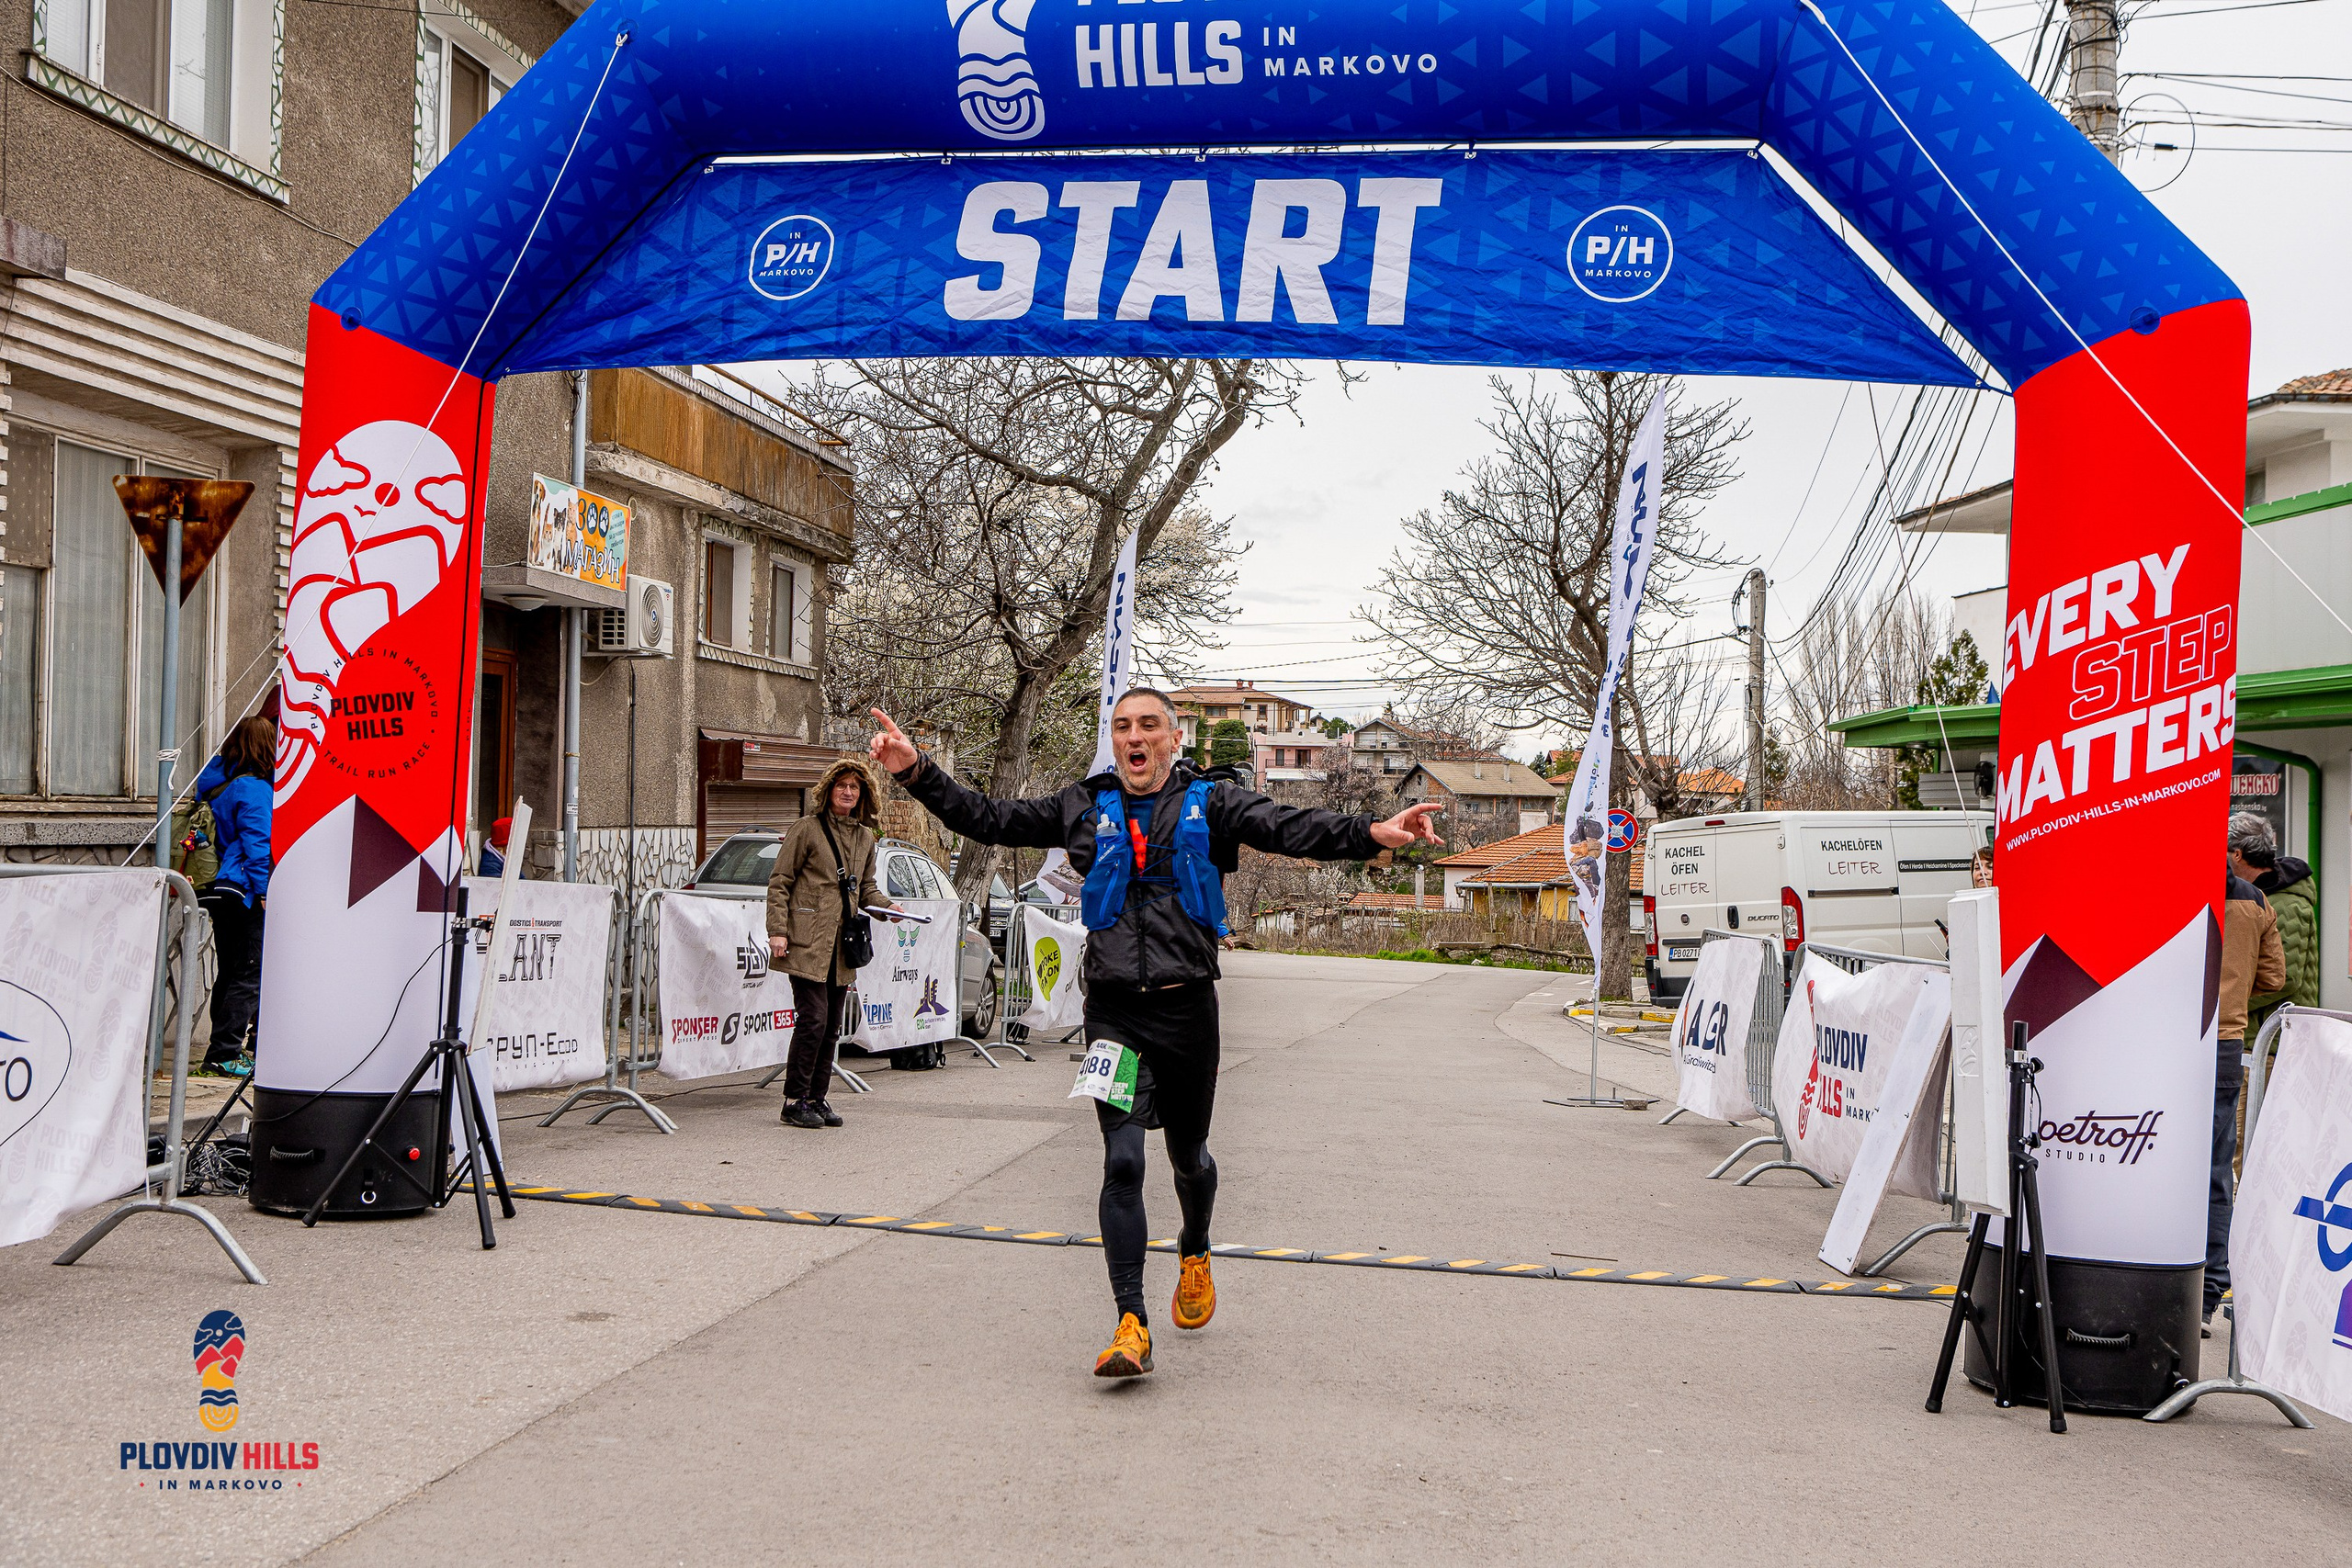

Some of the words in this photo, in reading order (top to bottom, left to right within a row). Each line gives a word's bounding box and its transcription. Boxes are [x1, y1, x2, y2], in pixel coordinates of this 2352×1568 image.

[1263, 27, 1296, 47] IN
[1076, 19, 1244, 88] HILLS
[1263, 53, 1439, 78] MARKOVO
[789, 231, 802, 240] IN
[1614, 224, 1629, 232] IN
[763, 242, 822, 268] P/H
[944, 177, 1443, 326] START
[1586, 235, 1655, 266] P/H
[759, 268, 815, 277] MARKOVO
[1585, 269, 1652, 278] MARKOVO
[565, 538, 621, 584] МАГАЗИН
[2001, 542, 2191, 695] EVERY
[2069, 604, 2233, 721] STEP
[310, 669, 332, 729] PLOVDIV
[333, 648, 375, 669] HILLS
[382, 649, 398, 660] IN
[403, 657, 439, 718] MARKOVO
[330, 691, 415, 718] PLOVDIV
[346, 716, 404, 741] HILLS
[323, 750, 359, 777] TRAIL
[368, 768, 397, 779] RUN
[402, 741, 431, 770] RACE
[1995, 671, 2237, 840] MATTERS
[2006, 768, 2222, 852] WWW.PLOVDIV-HILLS-IN-MARKOVO.COM
[1665, 845, 1705, 859] KACHEL
[1820, 838, 1883, 852] KACHELÖFEN
[1670, 862, 1699, 875] ÖFEN
[1827, 861, 1883, 875] LEITER
[1660, 882, 1711, 897] LEITER
[535, 919, 563, 928] TRANSPORT
[1747, 914, 1781, 922] DUCATO
[891, 965, 919, 985] Airways
[671, 1016, 719, 1045] SPONSER
[743, 1010, 774, 1036] SPORT
[1815, 1022, 1869, 1073] PLOVDIV
[1846, 1086, 1856, 1100] IN
[2045, 1148, 2106, 1164] STUDIO
